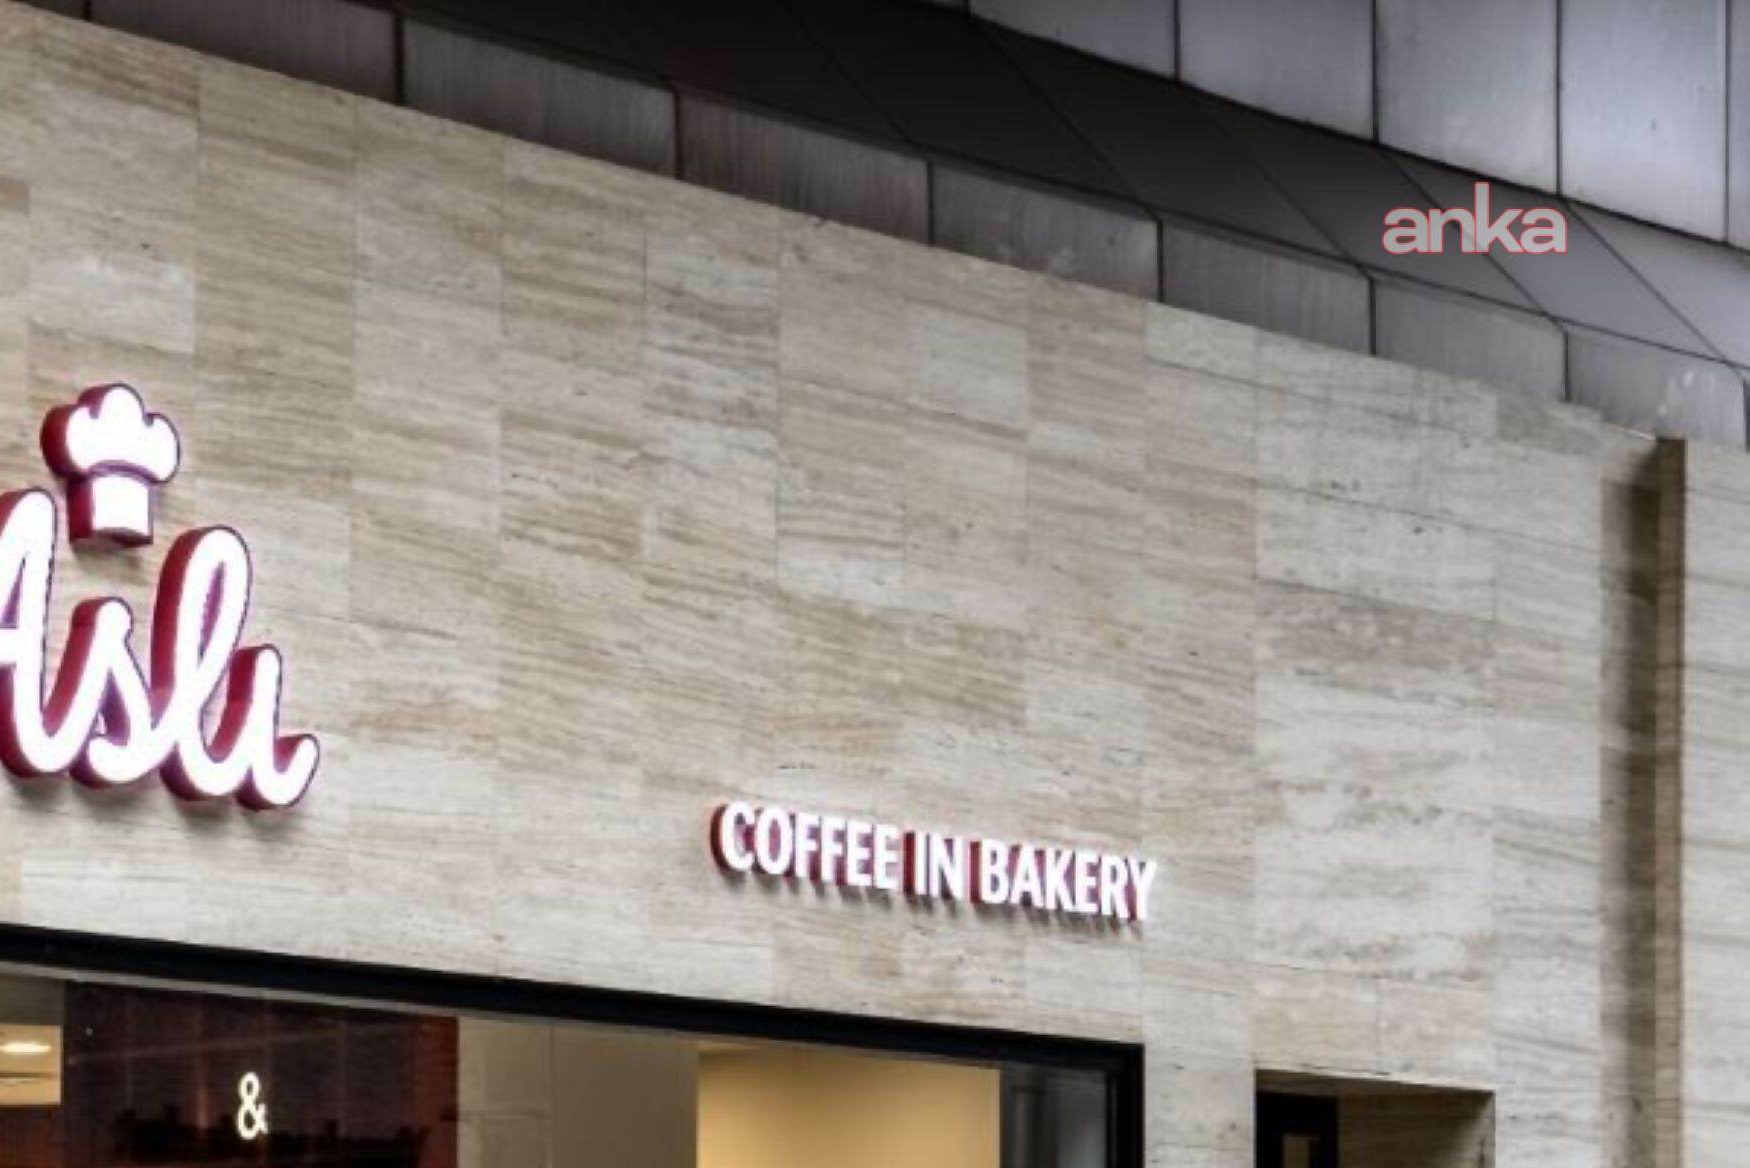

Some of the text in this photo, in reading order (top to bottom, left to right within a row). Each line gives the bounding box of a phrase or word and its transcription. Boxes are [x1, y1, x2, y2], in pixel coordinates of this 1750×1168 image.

[714, 801, 1157, 921] COFFEE IN BAKERY
[235, 1072, 269, 1140] &
